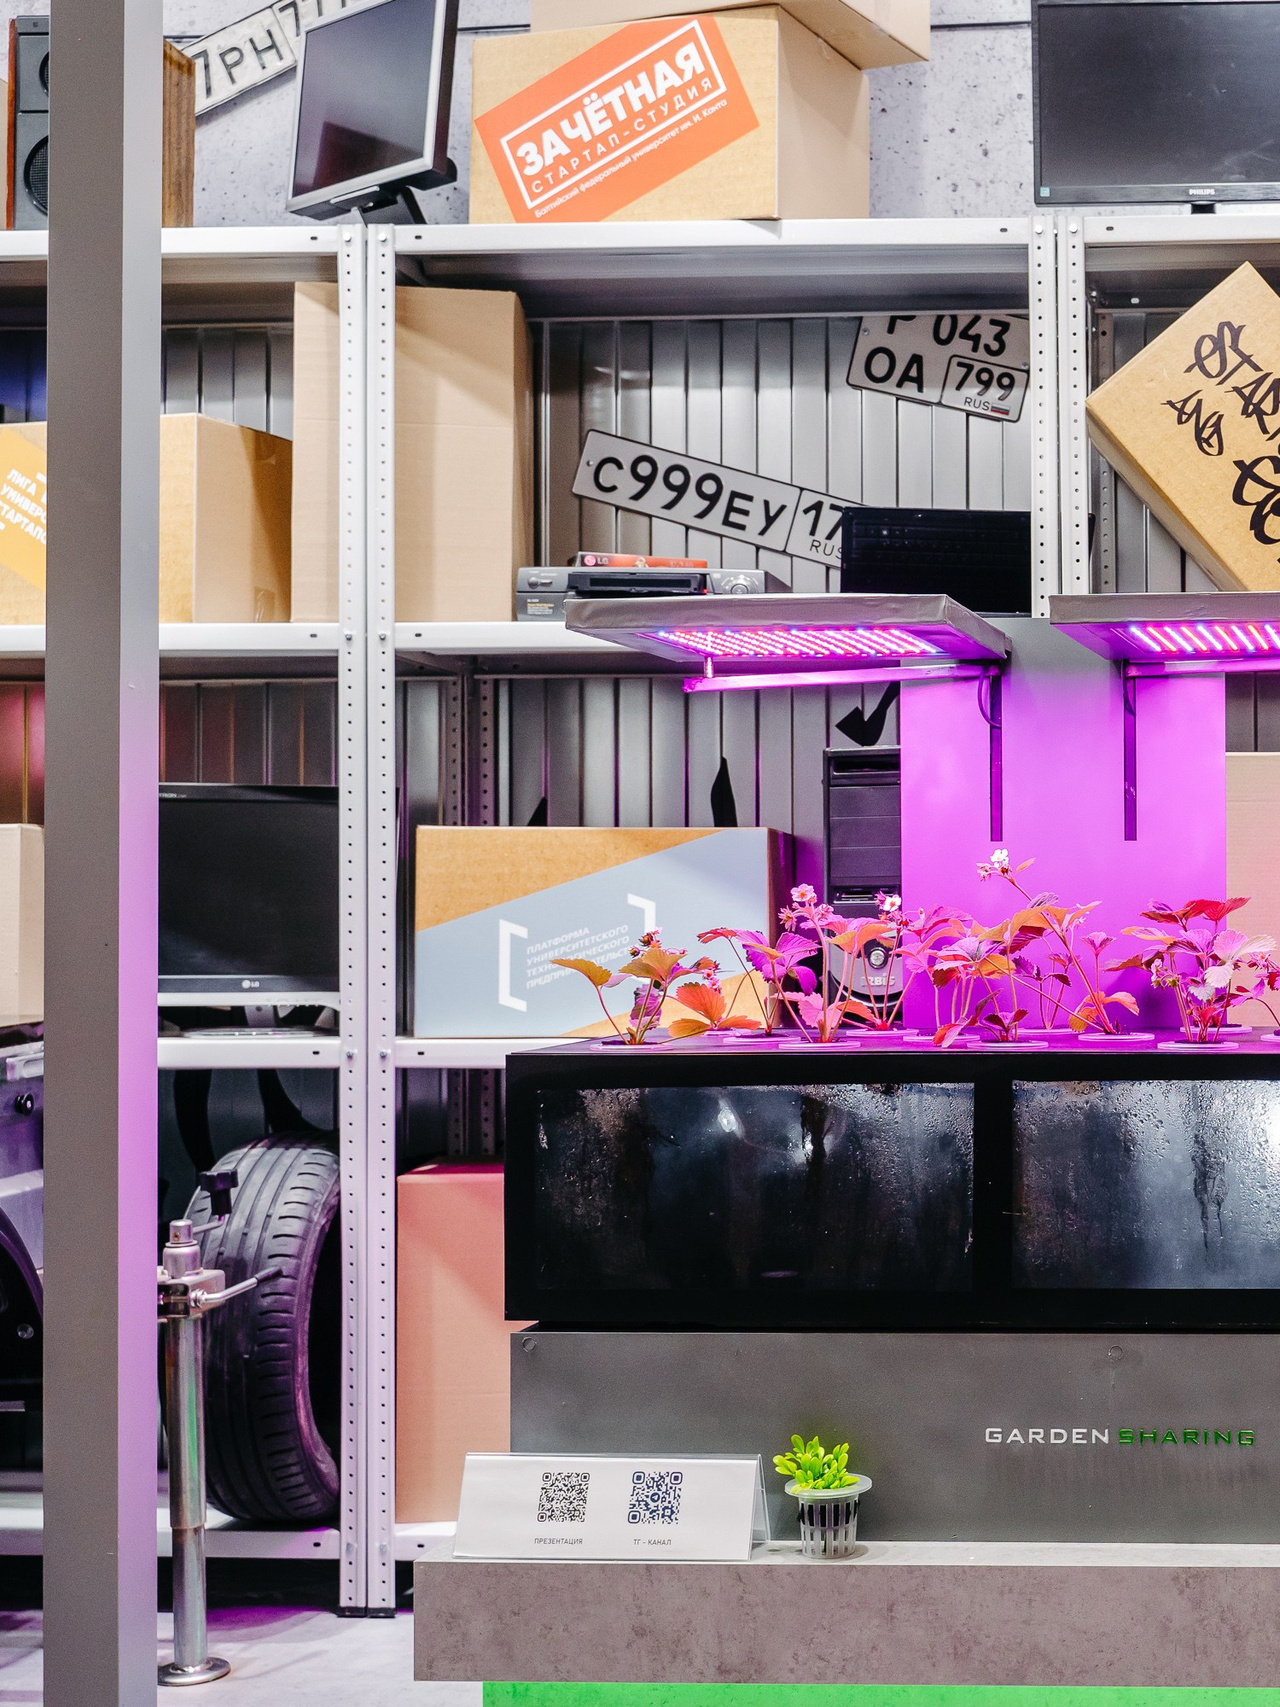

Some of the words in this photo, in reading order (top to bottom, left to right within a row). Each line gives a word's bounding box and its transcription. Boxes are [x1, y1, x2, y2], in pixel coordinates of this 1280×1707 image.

[516, 41, 706, 176] ЗАЧЁТНАЯ
[534, 187, 580, 219] Балтийский
[579, 156, 632, 192] федеральный
[631, 127, 680, 162] университет
[680, 120, 694, 132] им.
[693, 112, 704, 124] И.
[702, 99, 728, 117] Канта
[933, 314, 1010, 357] 043
[955, 361, 1015, 401] 799
[964, 396, 991, 411] RUS
[7, 468, 37, 497] ЛИГА
[526, 926, 590, 955] ПЛАТФОРМА
[526, 924, 629, 966] УНИВЕРСИТЕТСКОГО
[985, 1427, 1109, 1444] GARDEN
[1118, 1427, 1255, 1447] SHARING
[534, 1537, 583, 1546] ПРЕЗЕНТАЦИЯ
[647, 1538, 672, 1546] КАНАЛ
